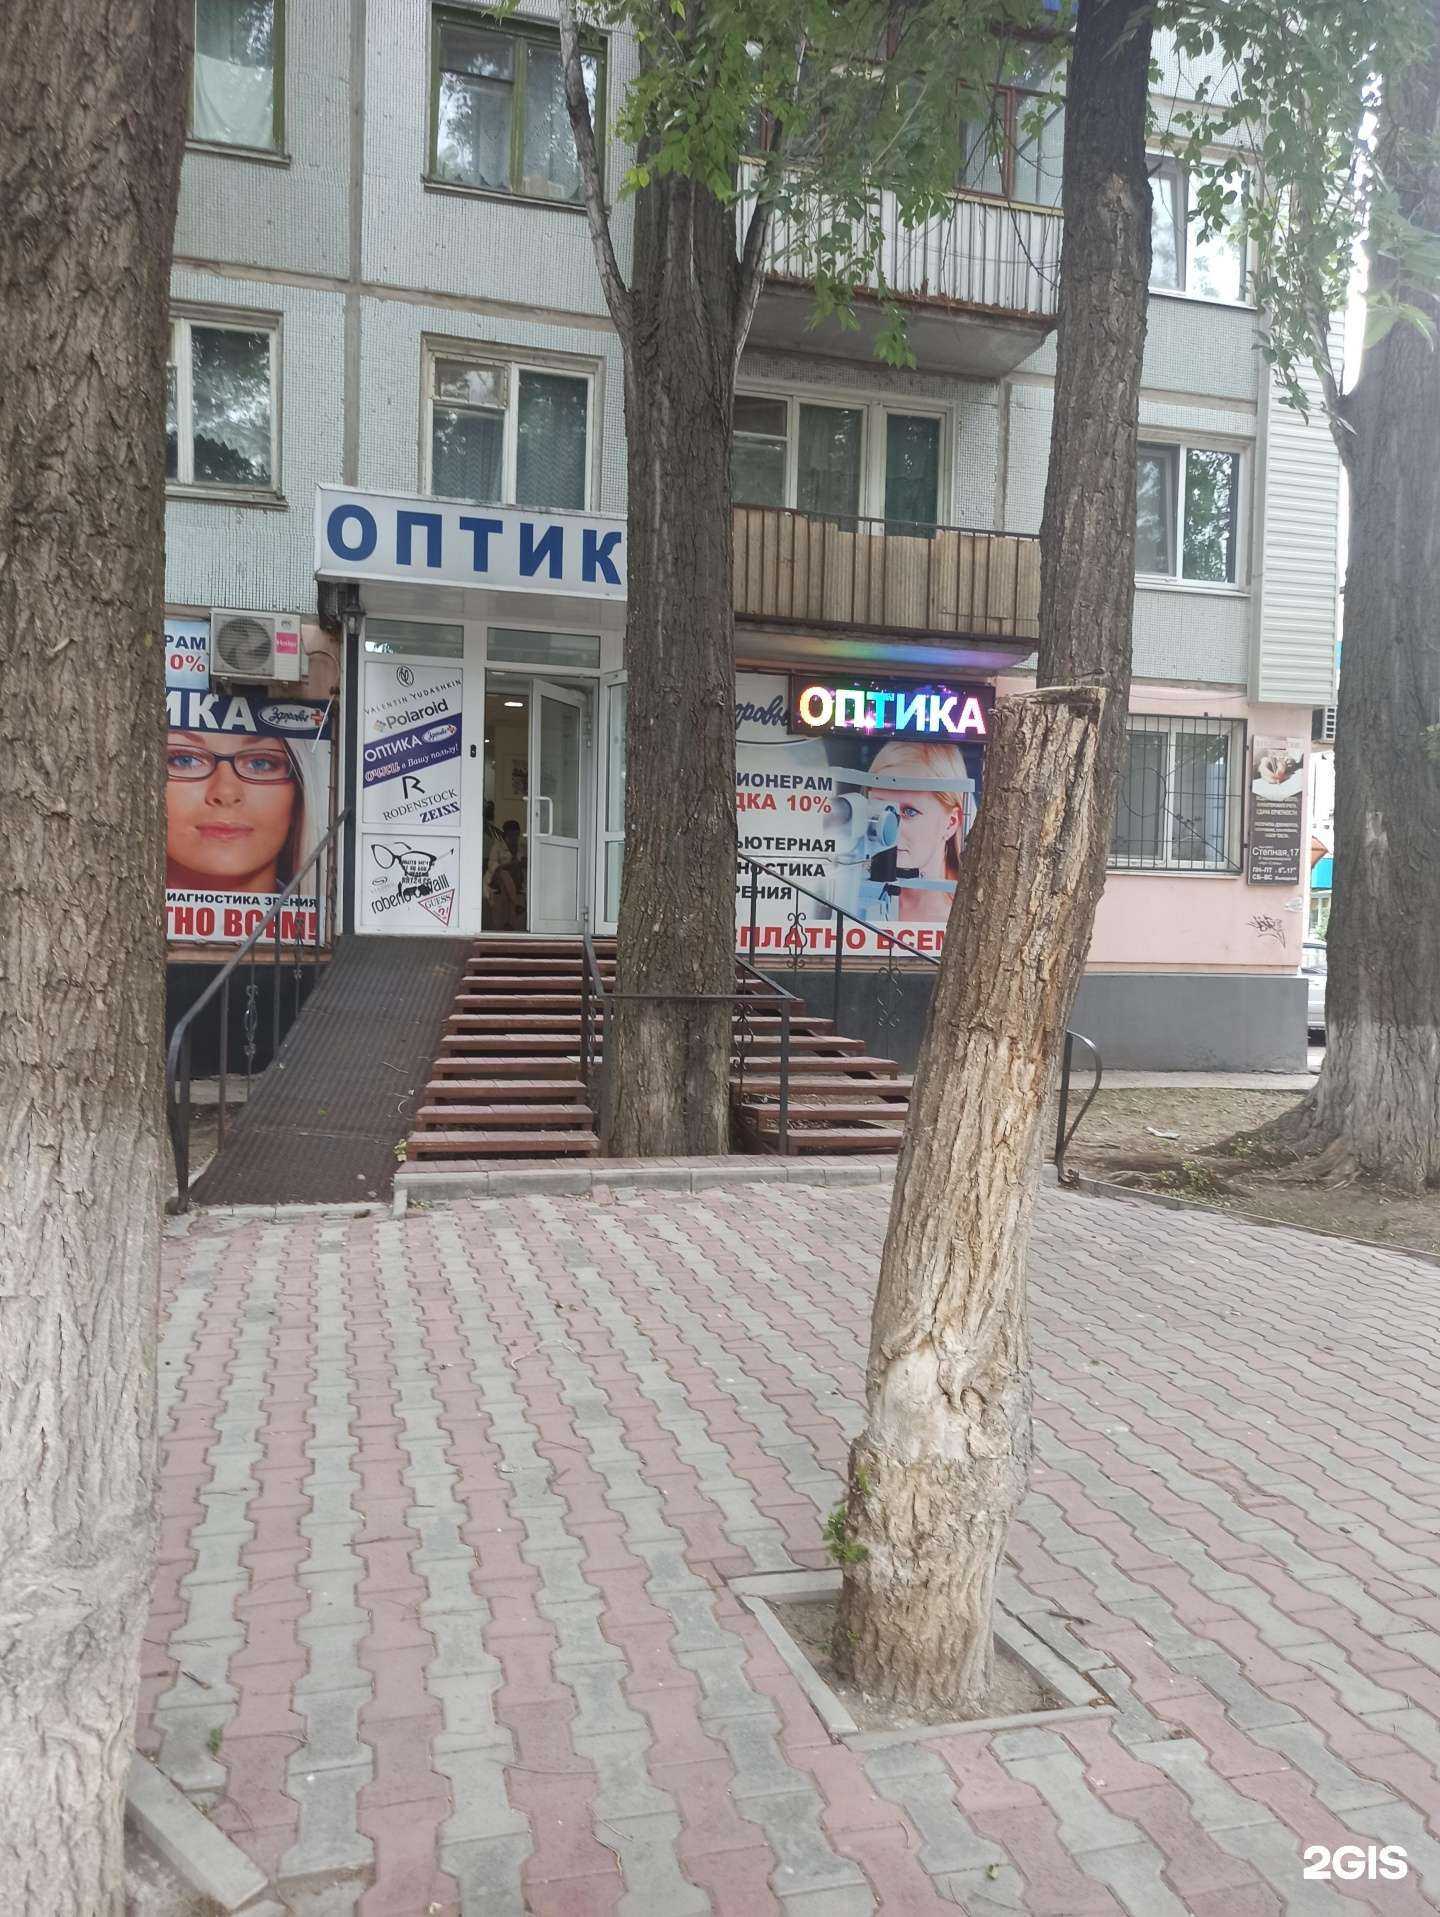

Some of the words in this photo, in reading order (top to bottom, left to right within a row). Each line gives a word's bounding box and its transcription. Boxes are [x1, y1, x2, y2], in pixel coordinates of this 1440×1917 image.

[386, 698, 449, 729] Polaroid
[799, 686, 987, 735] ОПТИКА
[364, 734, 423, 762] ОПТИКА
[407, 755, 430, 768] Вашу
[737, 772, 833, 791] ИОНЕРАМ
[382, 788, 458, 821] RODENSTOCK
[420, 801, 460, 824] ZEISS
[787, 795, 832, 813] 10%
[166, 892, 261, 905] ИАГНОСТИКА
